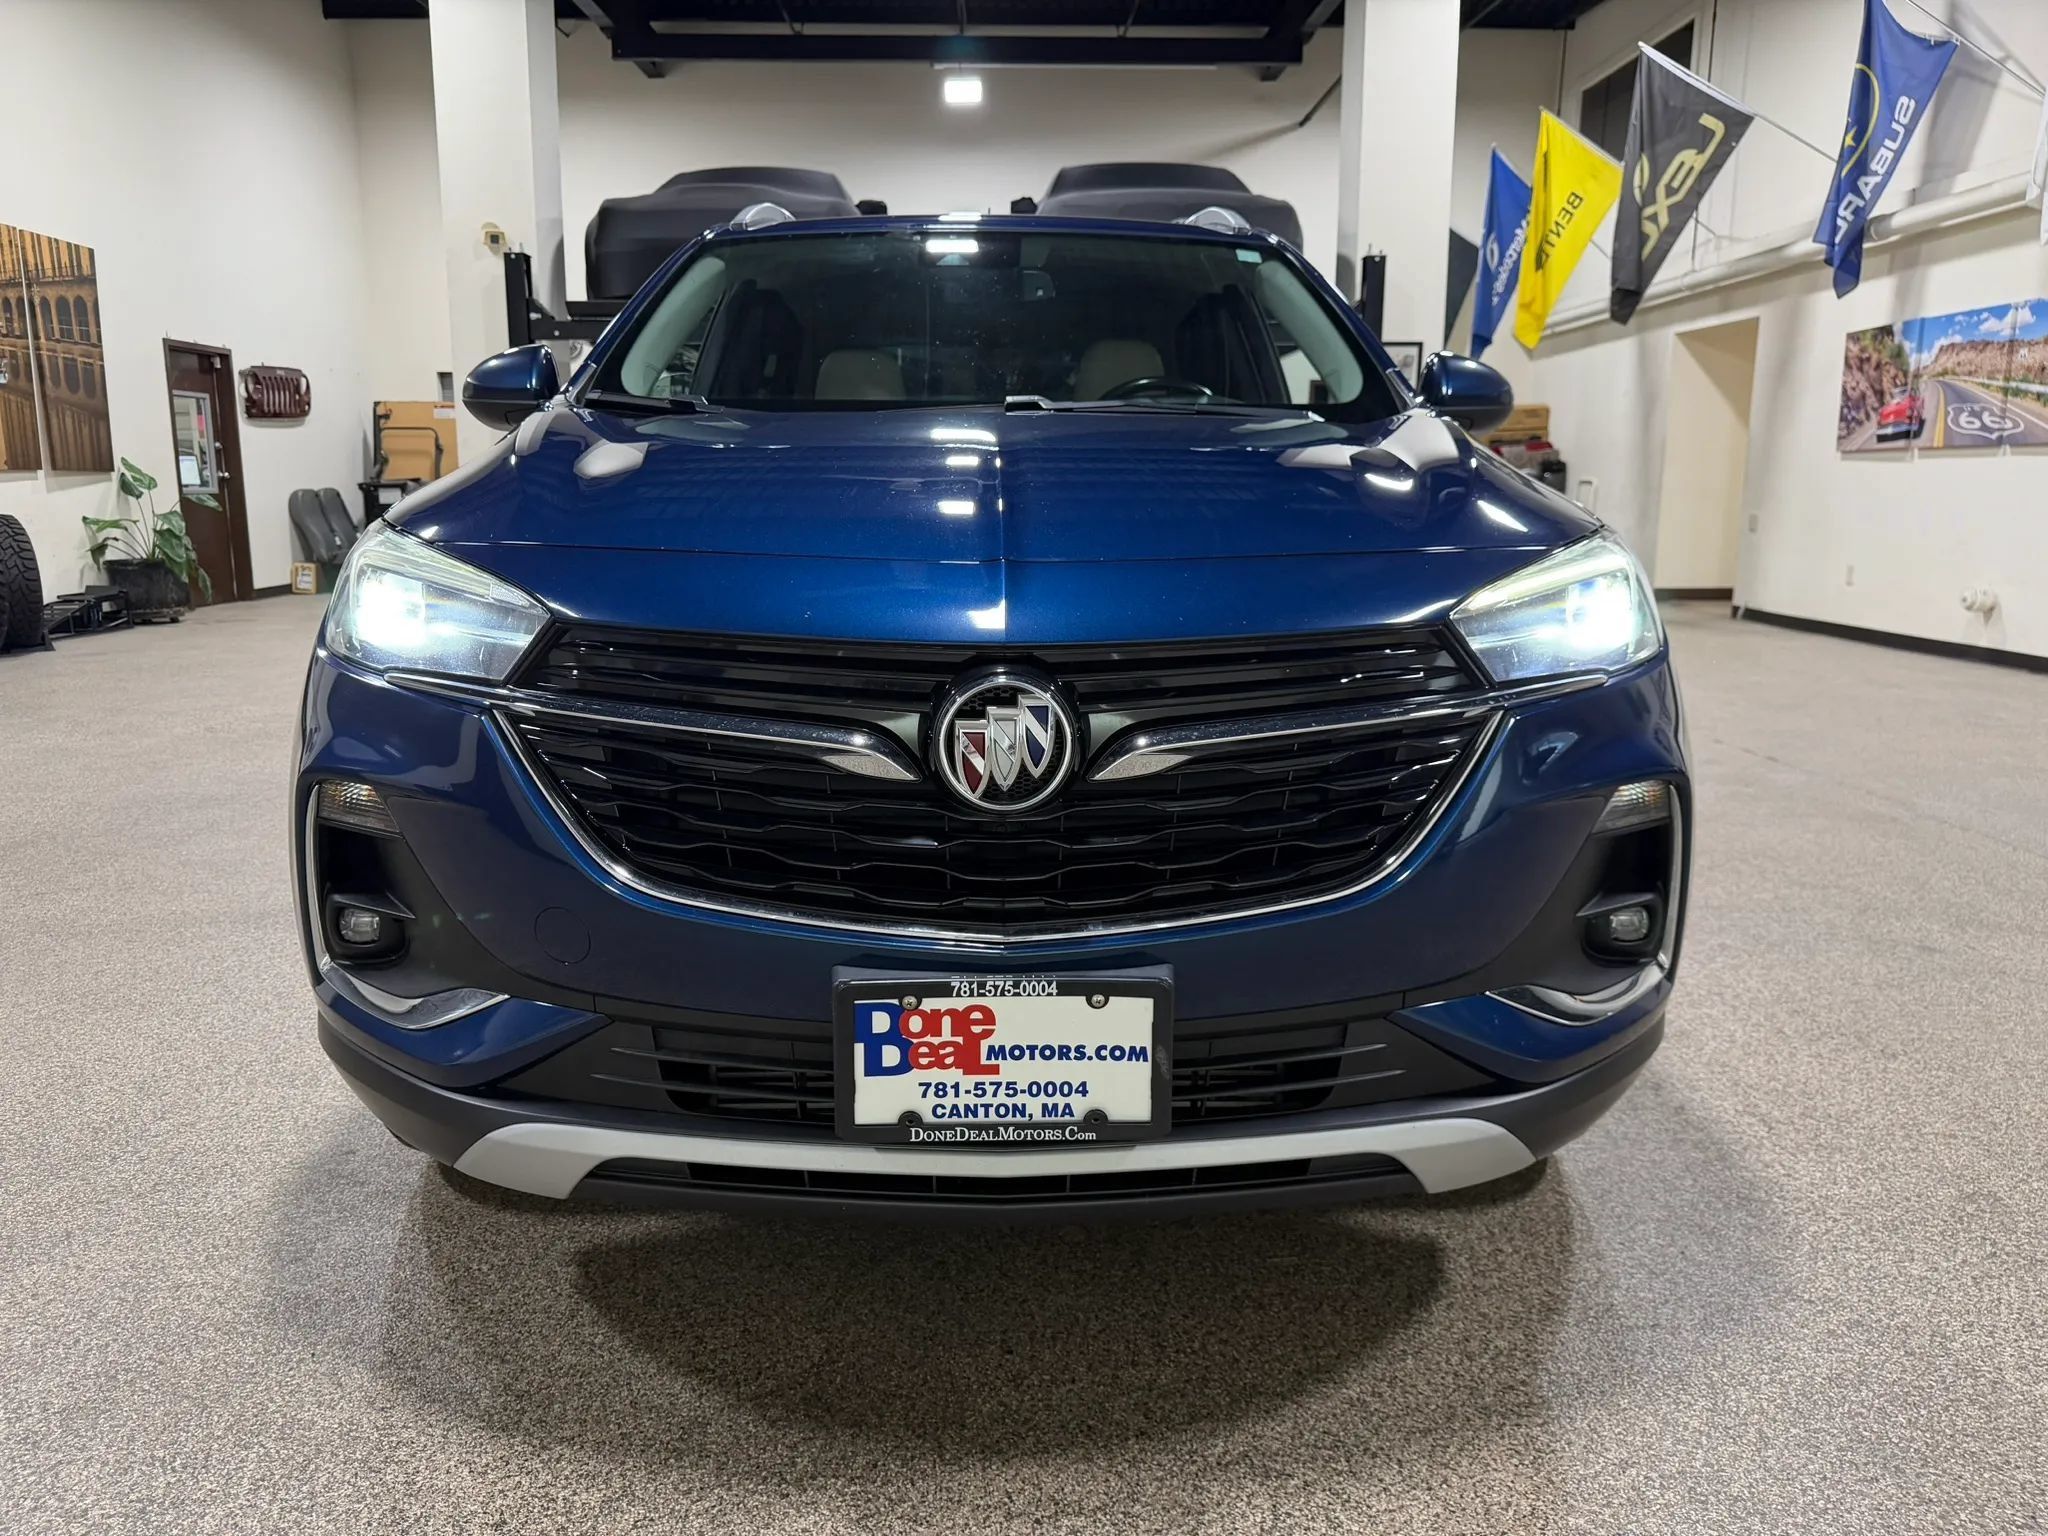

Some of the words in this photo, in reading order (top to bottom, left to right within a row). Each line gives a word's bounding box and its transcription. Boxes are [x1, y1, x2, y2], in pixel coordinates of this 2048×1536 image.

[1959, 411, 2013, 429] 66
[950, 980, 1058, 997] 781-575-0004
[854, 1002, 996, 1043] Done
[985, 1044, 1149, 1062] MOTORS.COM
[918, 1081, 1089, 1098] 781-575-0004
[931, 1103, 1034, 1121] CANTON,
[1041, 1103, 1075, 1118] MA
